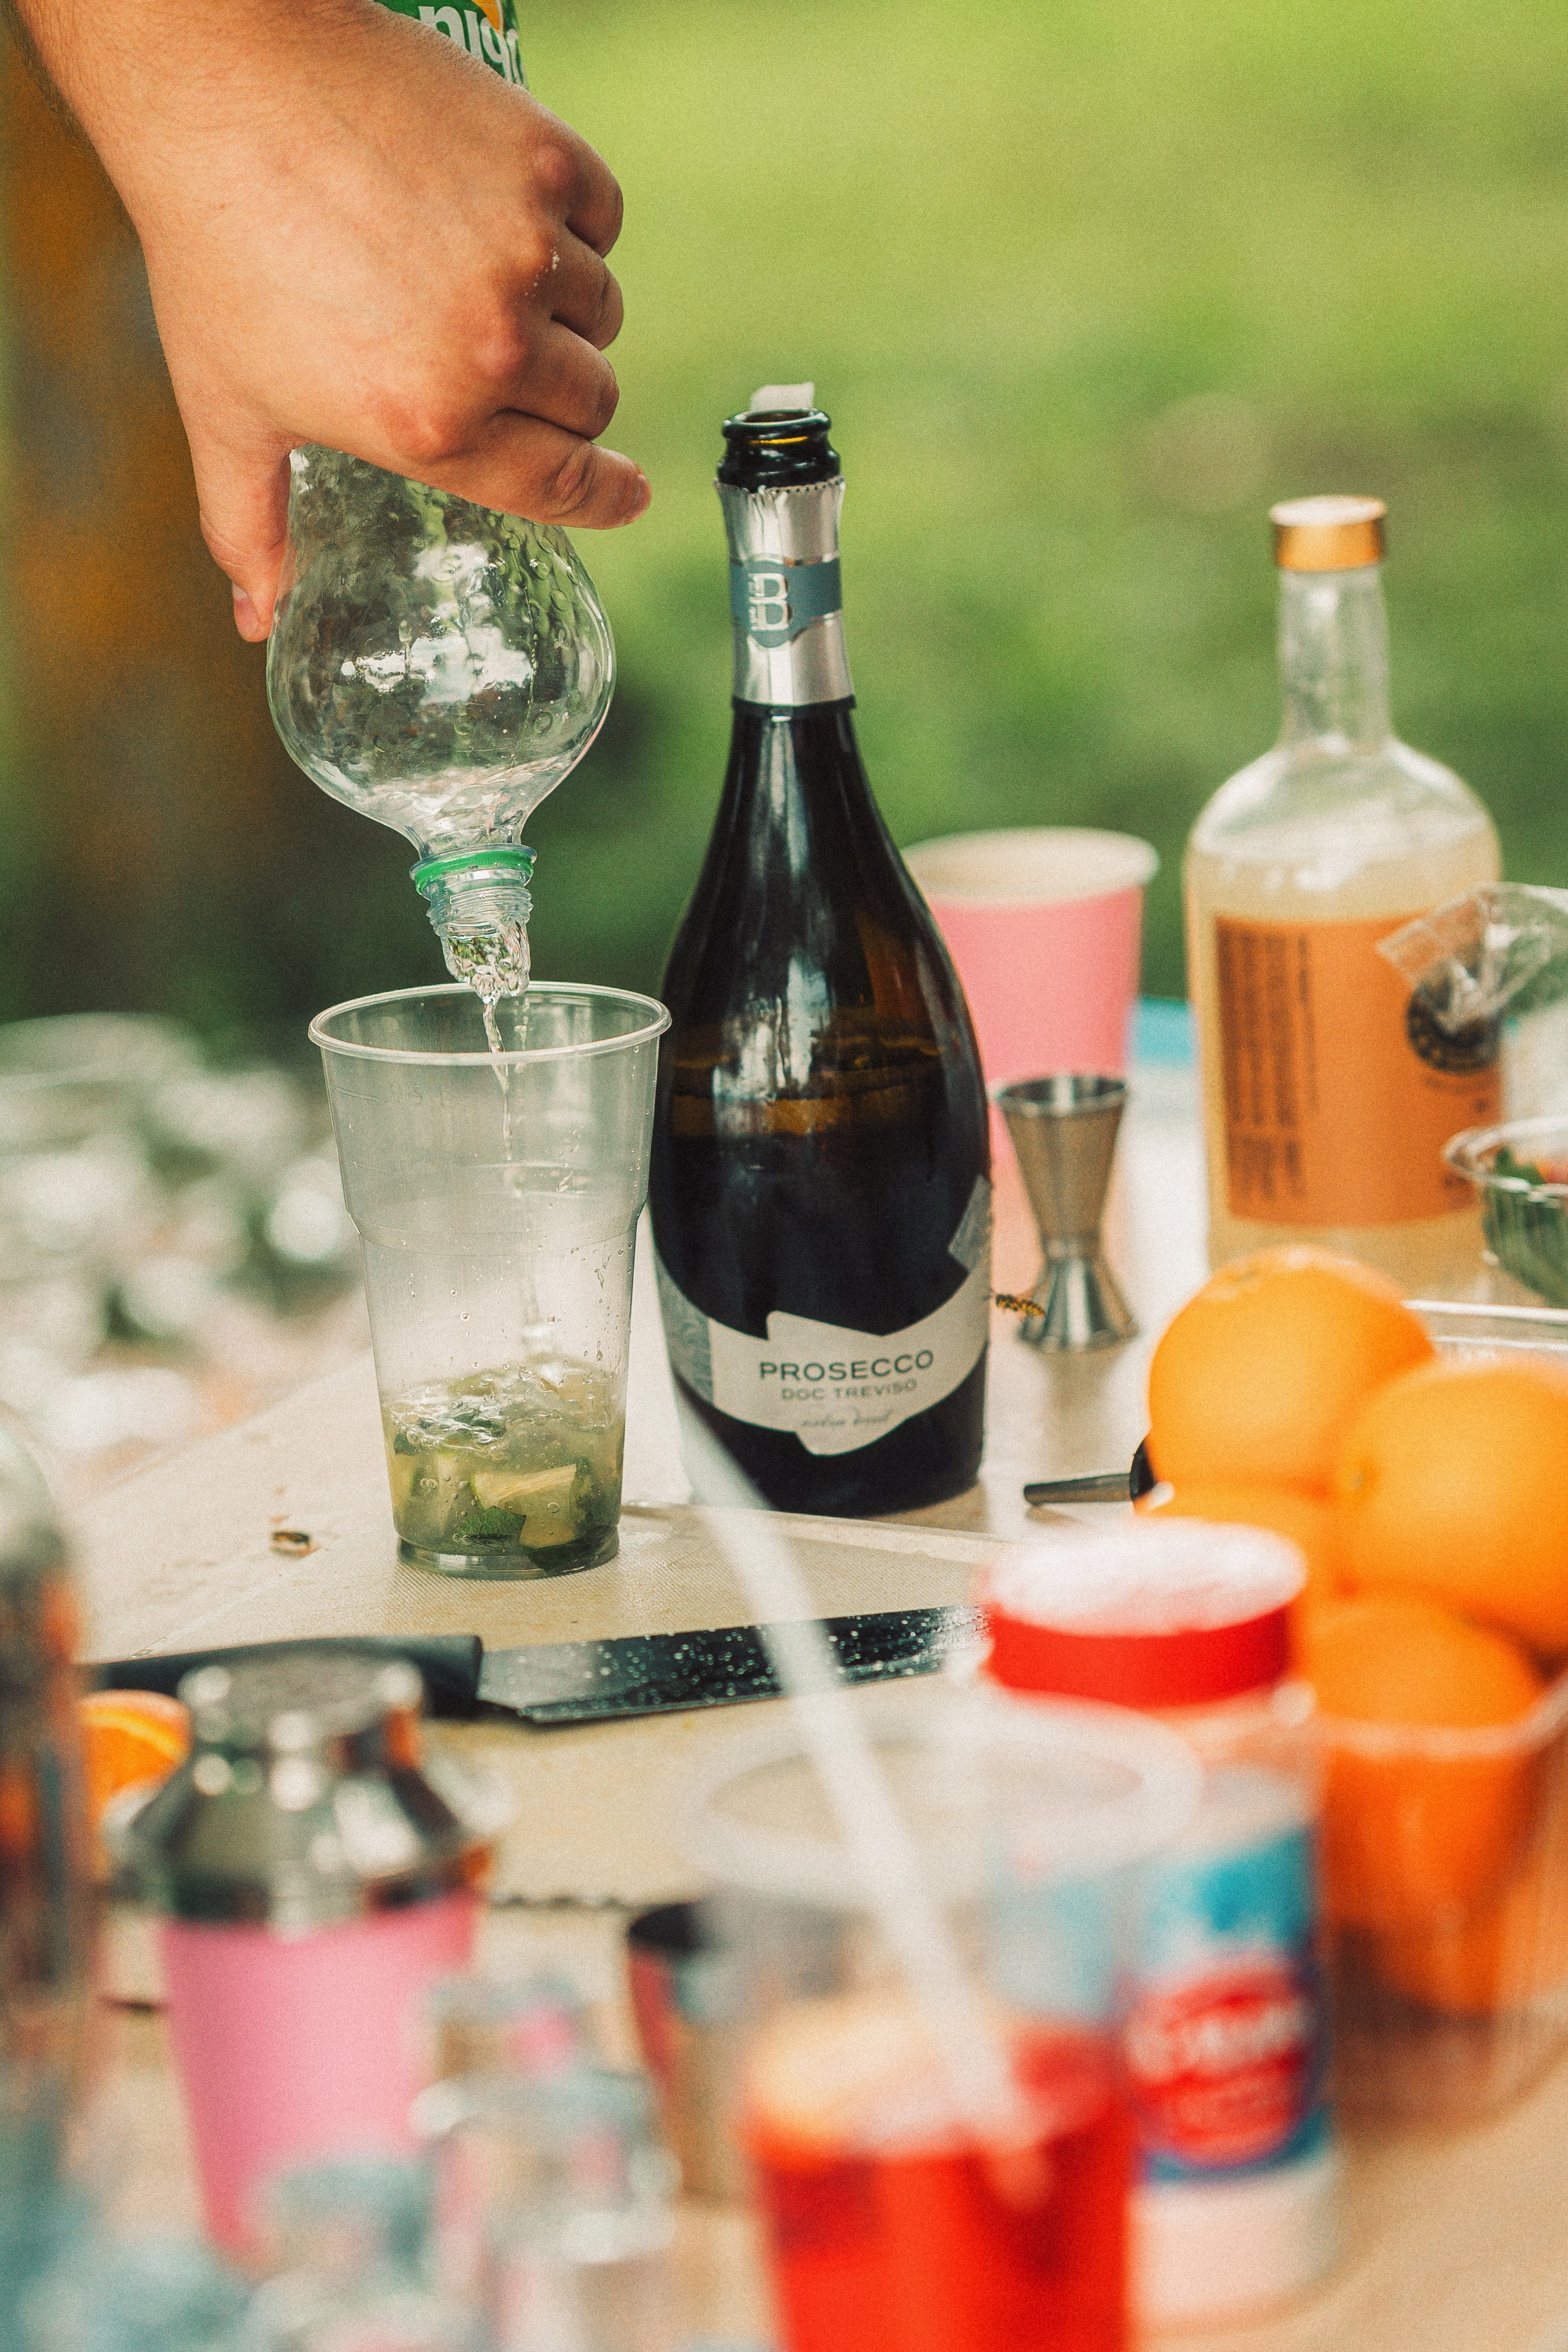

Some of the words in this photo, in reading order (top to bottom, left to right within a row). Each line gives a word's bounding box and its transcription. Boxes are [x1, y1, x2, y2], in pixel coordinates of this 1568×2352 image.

[759, 1349, 934, 1382] PROSECCO
[781, 1387, 825, 1401] DOC
[834, 1378, 918, 1400] TREVISO
